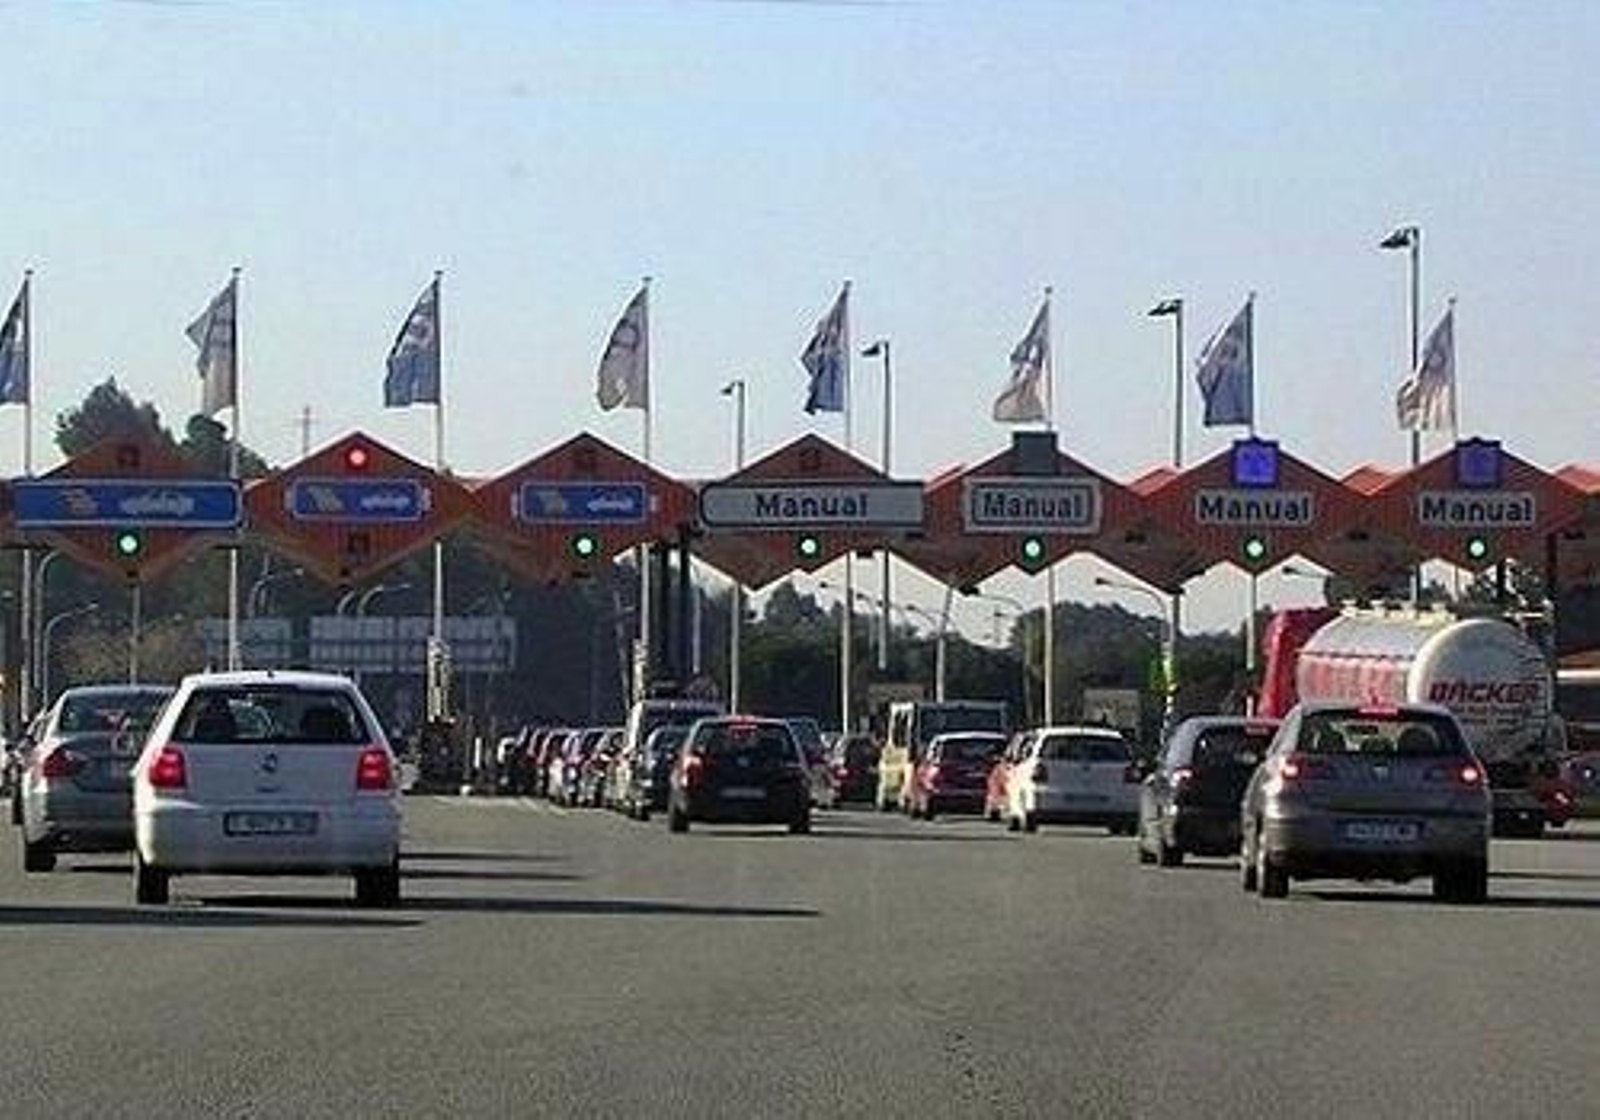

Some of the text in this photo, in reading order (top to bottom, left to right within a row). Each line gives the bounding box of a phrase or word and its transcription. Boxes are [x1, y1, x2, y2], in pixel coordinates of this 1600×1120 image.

[756, 492, 868, 518] Manual
[984, 493, 1082, 518] Manual
[1200, 495, 1310, 521] Manual
[1422, 497, 1533, 521] Manual
